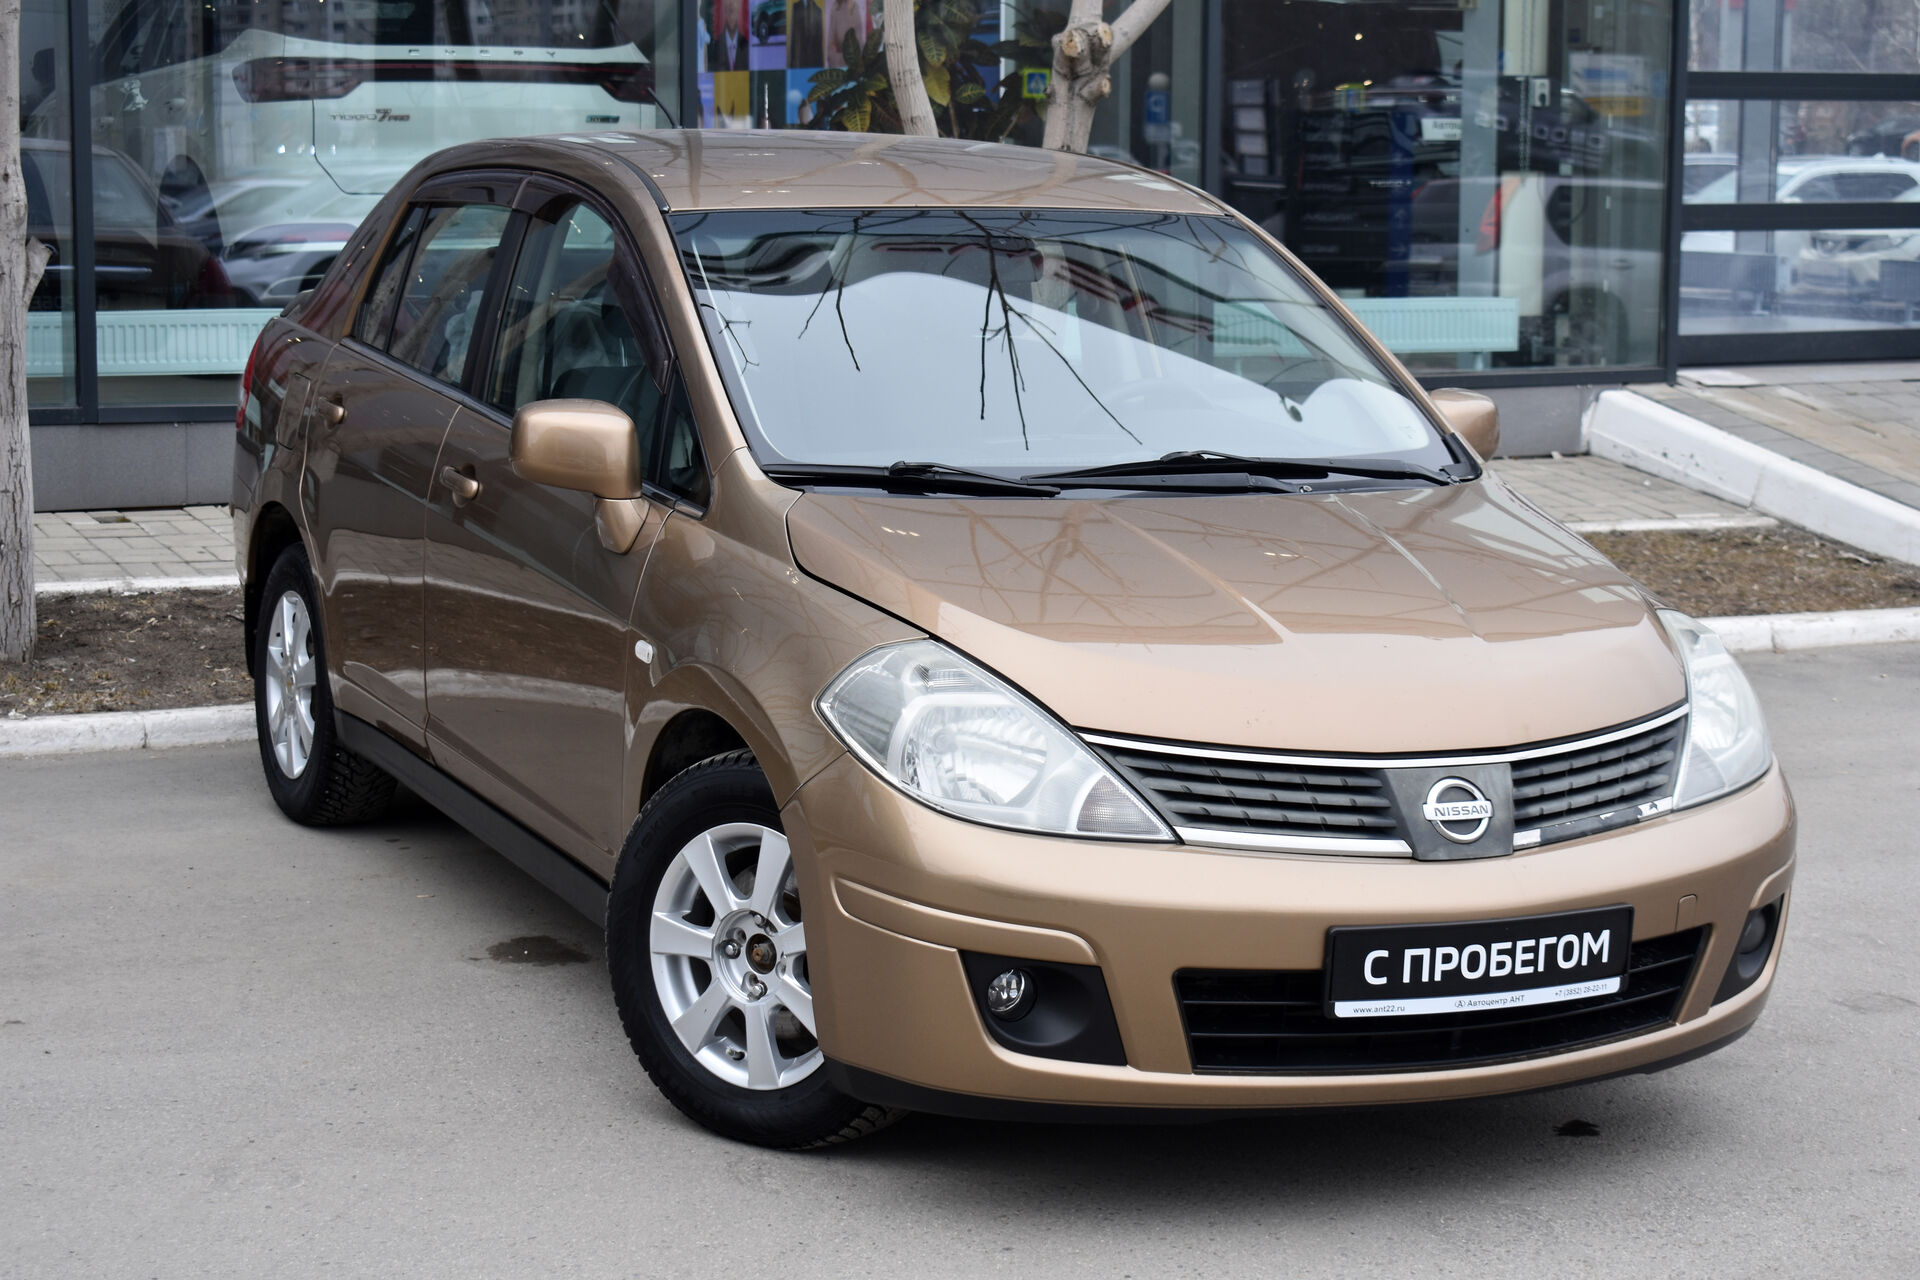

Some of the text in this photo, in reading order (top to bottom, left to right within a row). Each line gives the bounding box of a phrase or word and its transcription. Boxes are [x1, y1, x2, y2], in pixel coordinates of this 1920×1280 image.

[1434, 805, 1488, 816] NISSAN
[1363, 929, 1611, 985] С ПРОБЕГОМ
[1467, 998, 1508, 1007] Автоцентр
[1510, 994, 1525, 1003] АНТ
[1352, 1005, 1406, 1014] www.ant22.ru
